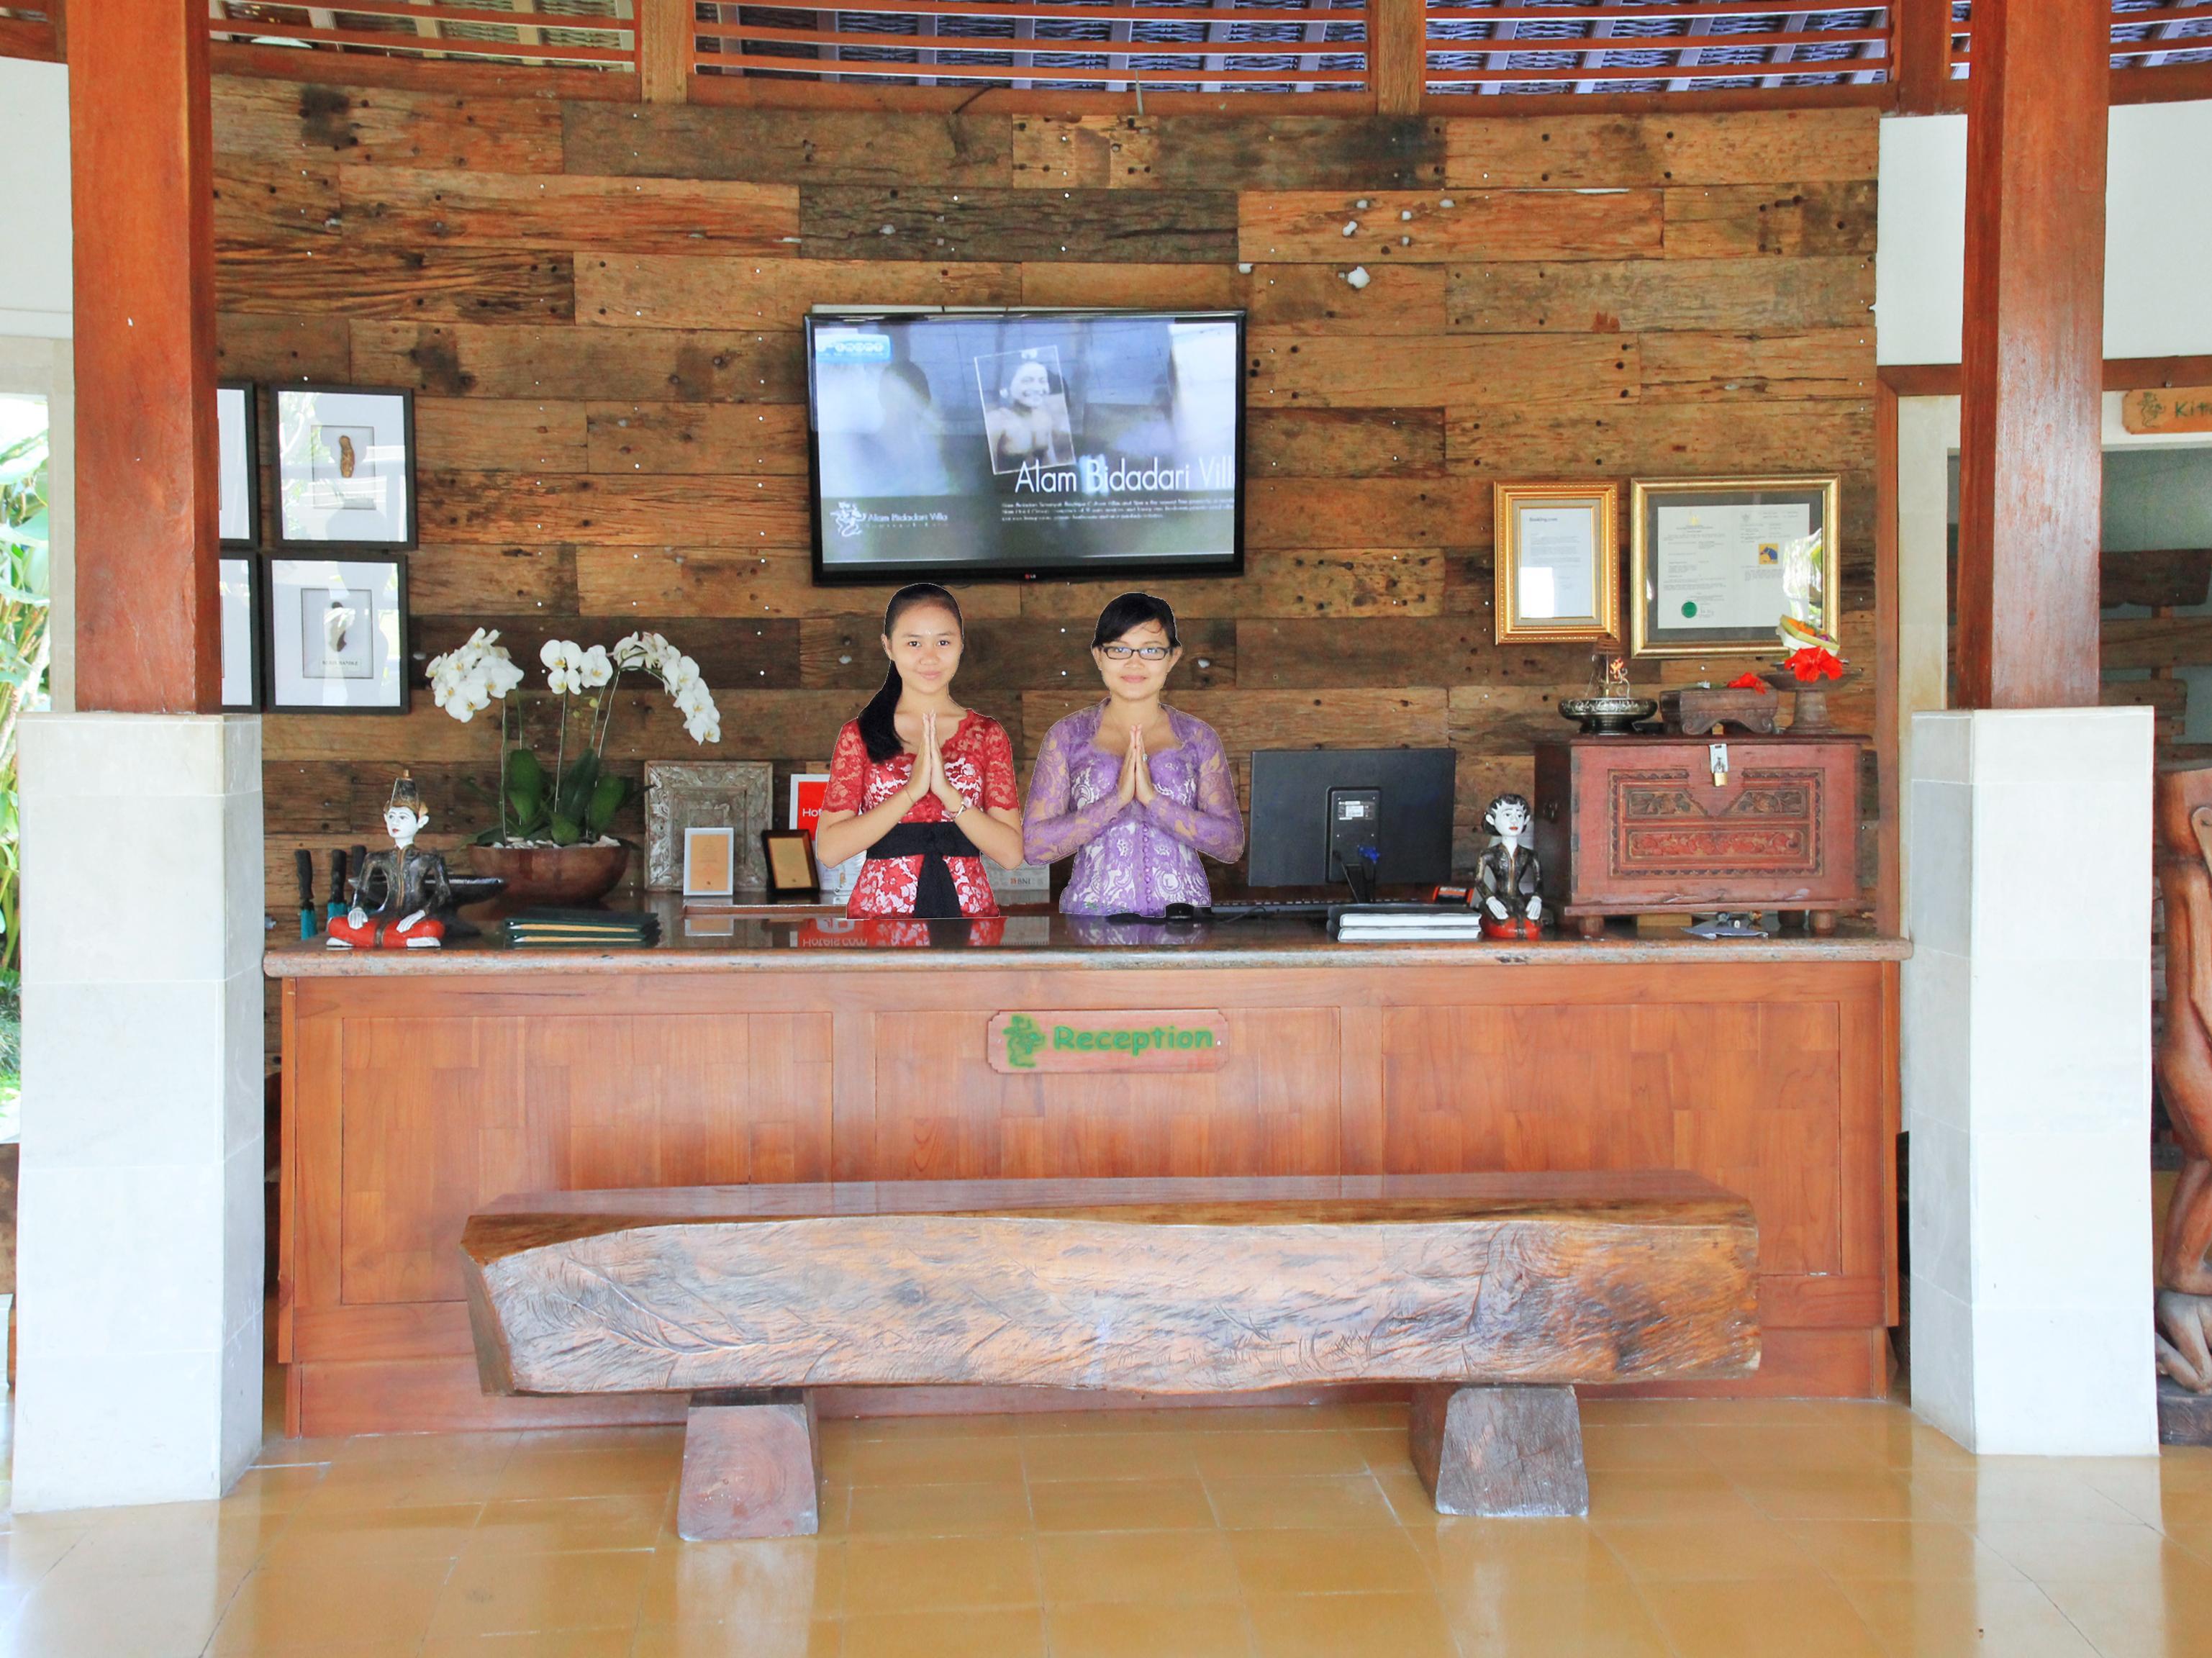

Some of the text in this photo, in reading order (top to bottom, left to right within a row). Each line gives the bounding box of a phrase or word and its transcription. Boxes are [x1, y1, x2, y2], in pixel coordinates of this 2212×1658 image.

[1015, 455, 1236, 494] Alam Bidadari Vill
[1053, 1025, 1214, 1056] Reception
